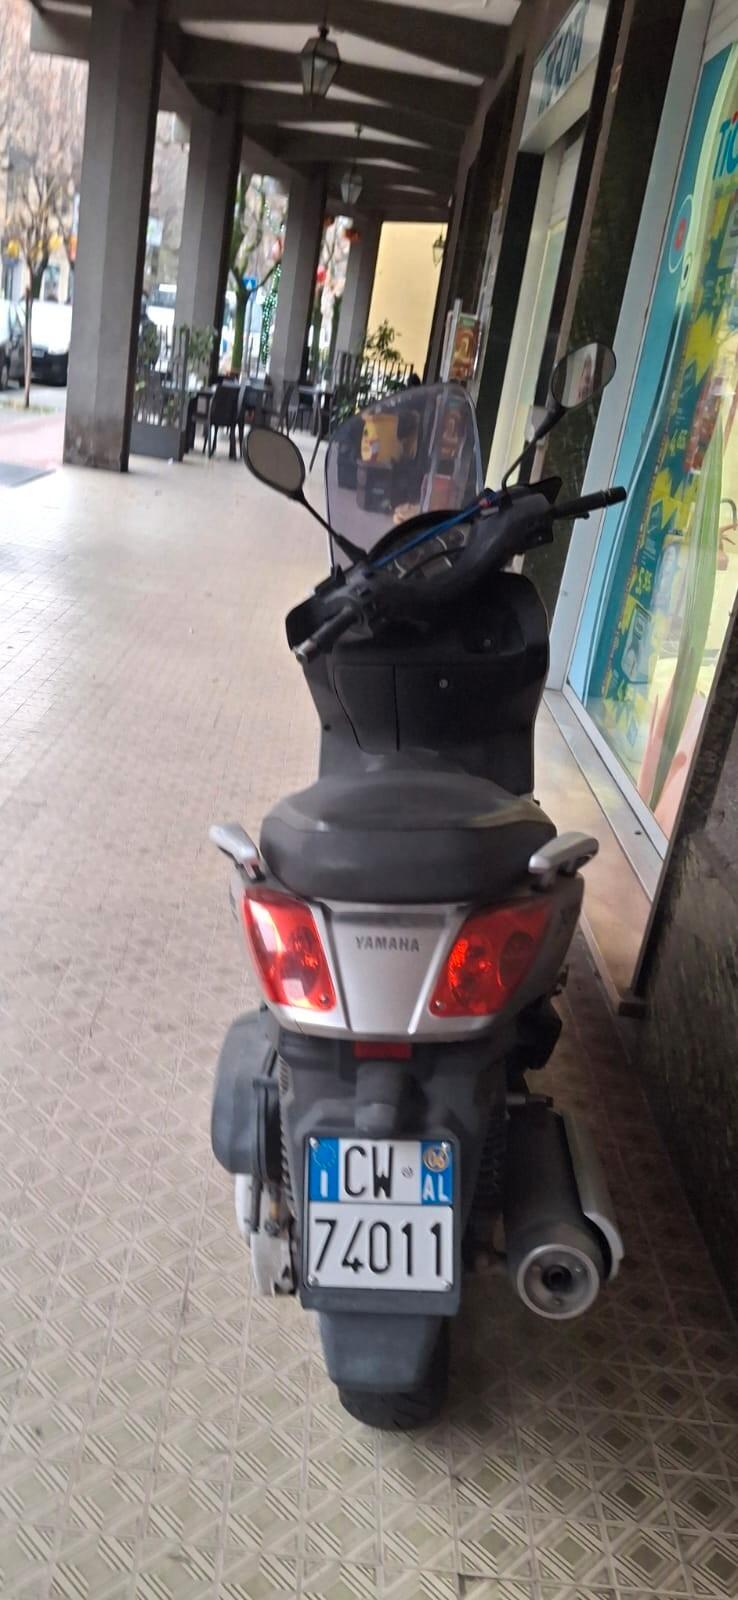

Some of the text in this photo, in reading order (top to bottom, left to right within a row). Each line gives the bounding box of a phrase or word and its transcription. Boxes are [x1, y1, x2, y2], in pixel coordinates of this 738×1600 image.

[355, 936, 419, 952] YAMAHA
[320, 1170, 328, 1198] I
[344, 1146, 393, 1199] CW
[422, 1173, 449, 1202] AL
[314, 1218, 441, 1276] 74011
